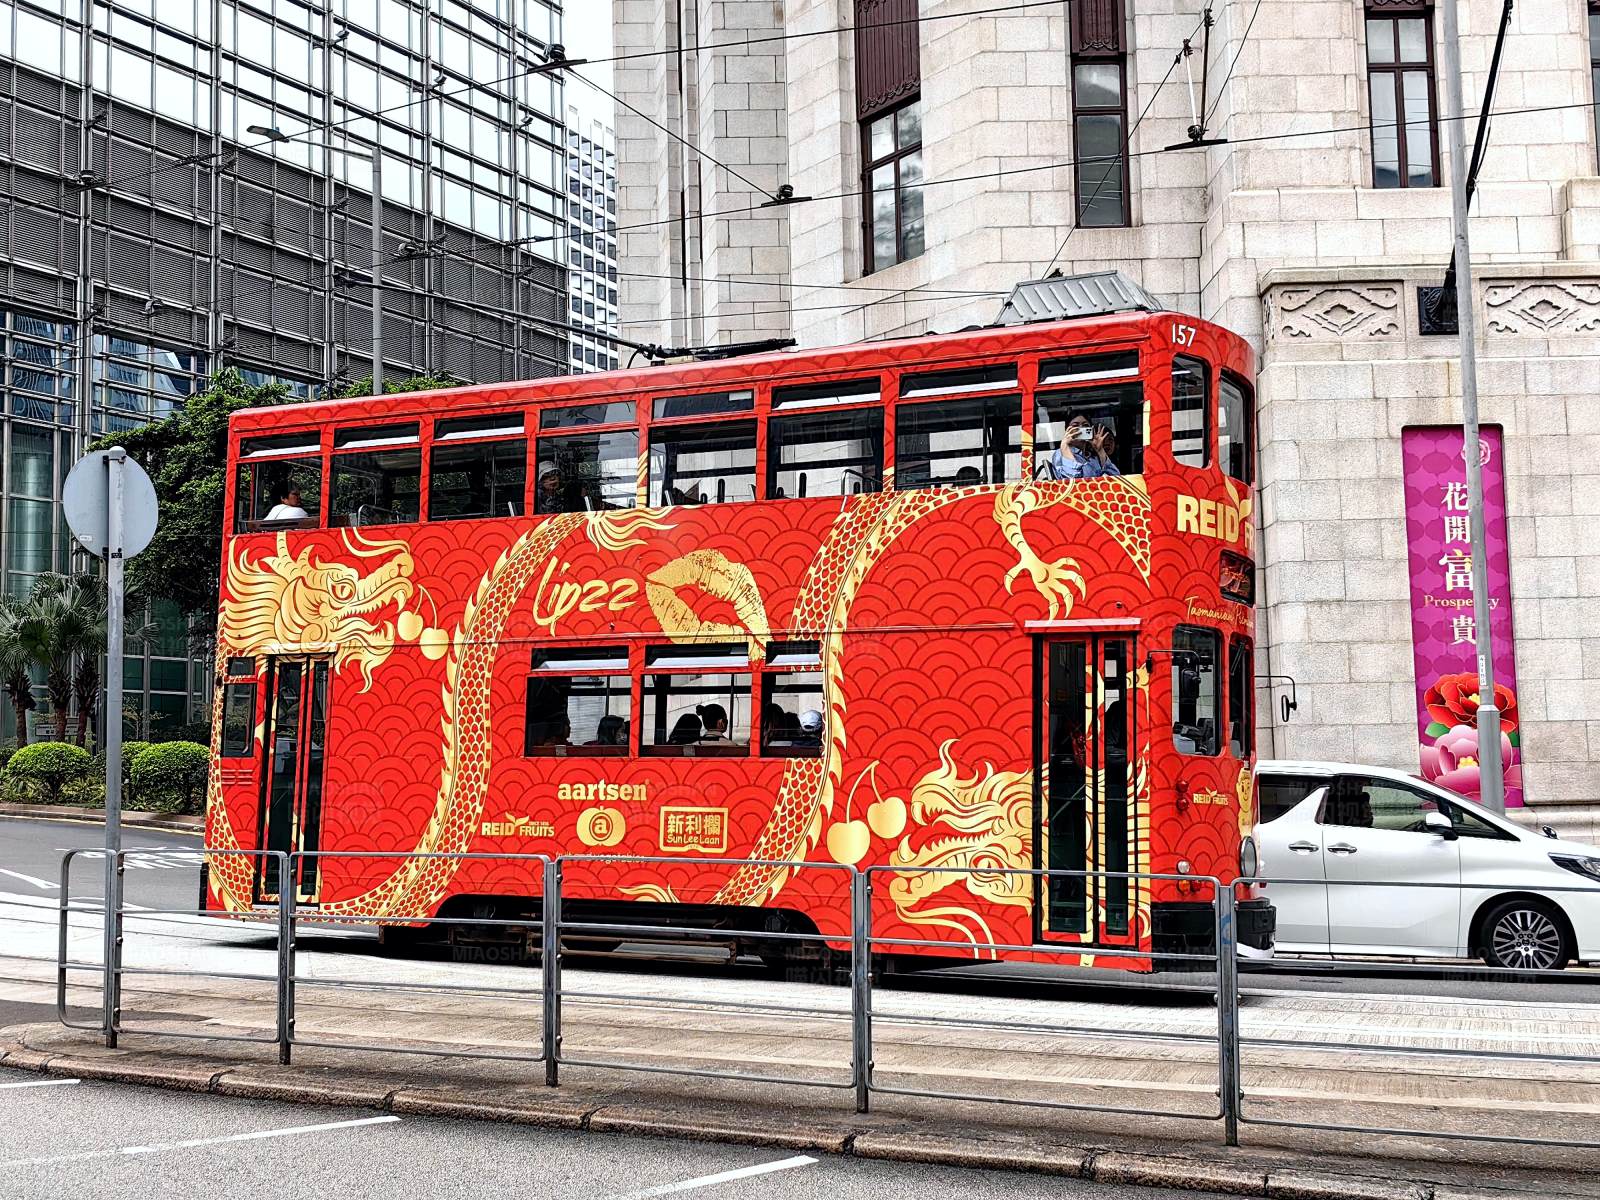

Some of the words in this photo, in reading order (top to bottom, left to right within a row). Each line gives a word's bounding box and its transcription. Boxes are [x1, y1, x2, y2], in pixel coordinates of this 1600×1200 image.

[1172, 323, 1196, 347] 157
[1177, 494, 1239, 543] REID
[1424, 595, 1499, 610] Prospey
[558, 778, 647, 801] aartsen
[481, 822, 515, 836] REID
[519, 826, 555, 837] FRUITS
[666, 834, 683, 844] Sun
[683, 834, 699, 844] Lee
[700, 834, 720, 845] Laan
